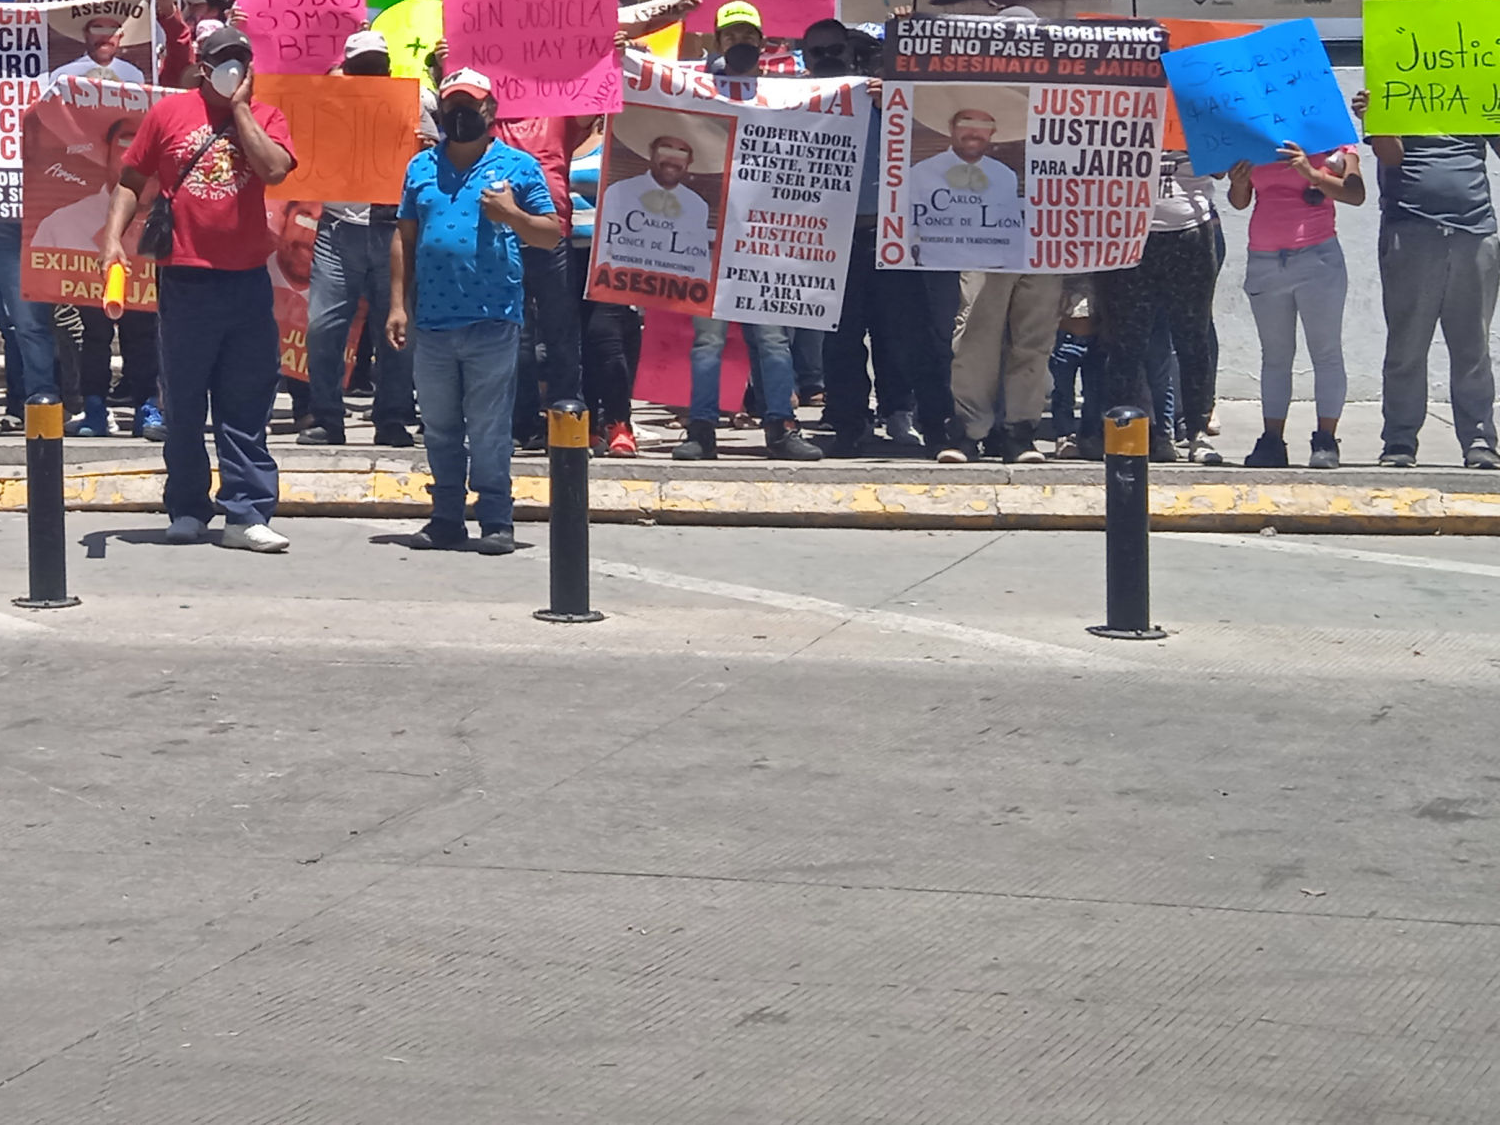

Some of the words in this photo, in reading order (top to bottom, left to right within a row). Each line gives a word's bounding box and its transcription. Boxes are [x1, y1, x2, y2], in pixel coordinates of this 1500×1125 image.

[70, 1, 144, 20] ASESINO
[257, 10, 359, 33] SOMOS
[462, 1, 504, 33] SIN
[897, 20, 1007, 40] EXIGIMOS
[1013, 24, 1041, 41] AL
[471, 45, 504, 67] NO
[523, 39, 567, 63] HAY
[899, 38, 943, 55] QUE
[951, 39, 982, 56] NO
[989, 41, 1045, 58] PASE
[1053, 43, 1099, 59] POR
[1106, 43, 1161, 61] ALTO
[1396, 22, 1500, 72] "Justic
[896, 56, 919, 72] EL
[928, 57, 1050, 75] ASESINATO
[1058, 59, 1086, 75] DE
[1093, 60, 1161, 77] JAIRO
[1033, 88, 1158, 119] JUSTICIA
[1382, 81, 1470, 115] PARA
[743, 123, 858, 150] GOBERNADOR,
[1031, 118, 1155, 148] JUSTICIA
[740, 138, 757, 151] SI
[762, 142, 782, 156] LA
[785, 144, 858, 164] JUSTICIA
[1031, 161, 1067, 175] PARA
[1072, 149, 1152, 178] JAIRO
[737, 169, 771, 186] QUE
[776, 173, 806, 189] SER
[810, 177, 852, 193] PARA
[807, 161, 854, 178] TIENE
[880, 88, 909, 266] ASESINO
[771, 186, 822, 204] TODOS
[1030, 178, 1150, 208] JUSTICIA
[747, 209, 829, 230] EXIJIMOS
[1029, 209, 1146, 239] JUSTICIA
[746, 225, 825, 246] JUSTICIA
[734, 240, 782, 258] PARA
[785, 246, 837, 263] JAIRO
[1029, 240, 1142, 268] JUSTICIA
[594, 269, 709, 304] ASESINO
[726, 266, 770, 285] PENA
[774, 272, 837, 291] MAXIMA
[759, 286, 803, 302] PARA
[735, 296, 756, 311] EL
[758, 299, 826, 318] ASESINO
